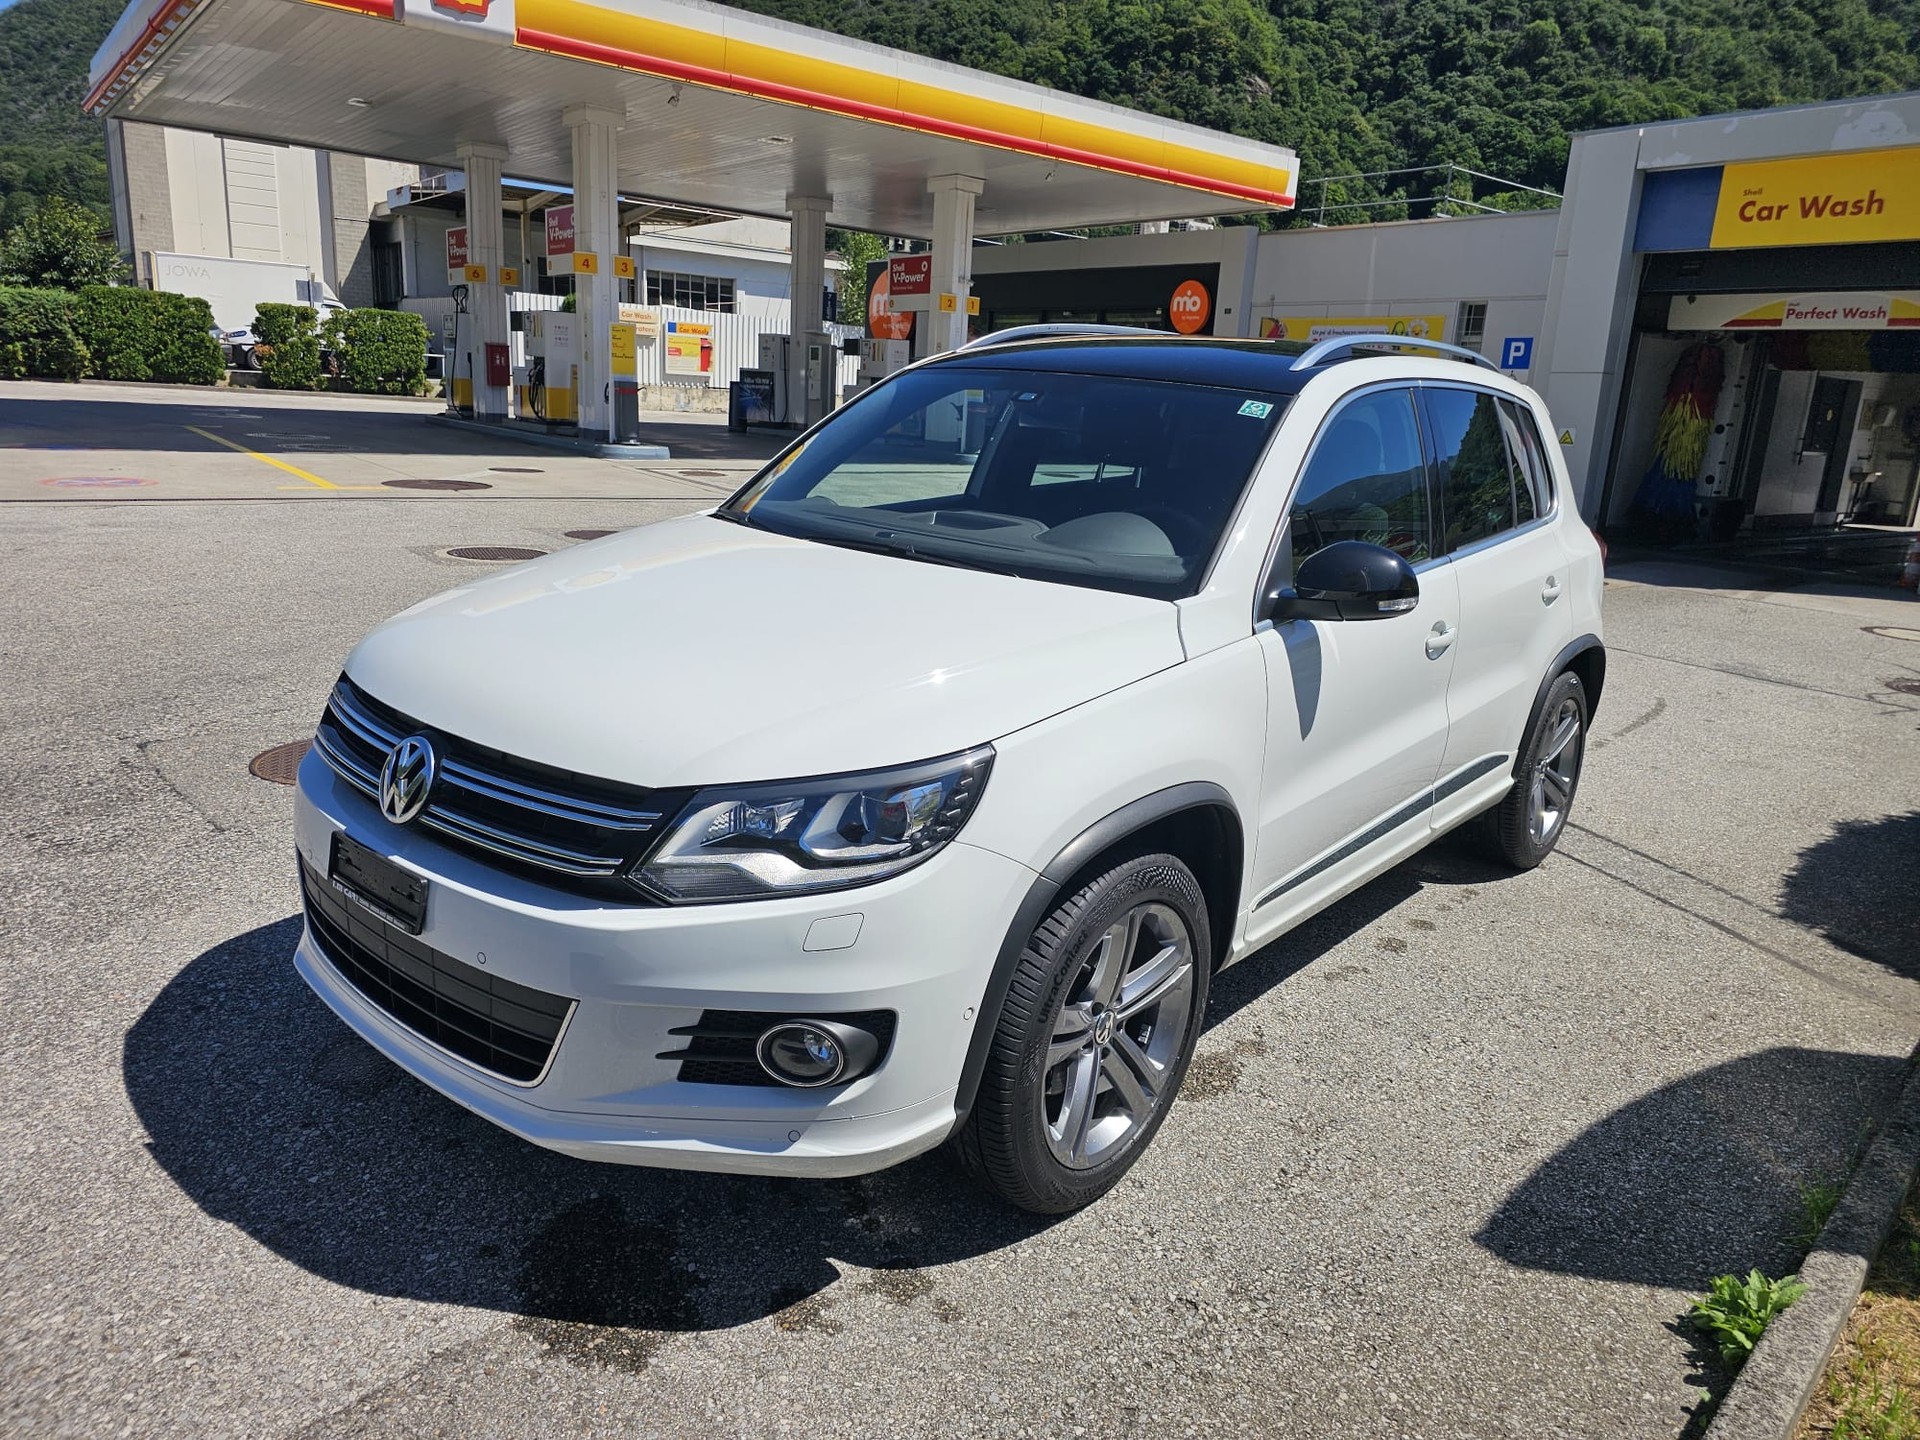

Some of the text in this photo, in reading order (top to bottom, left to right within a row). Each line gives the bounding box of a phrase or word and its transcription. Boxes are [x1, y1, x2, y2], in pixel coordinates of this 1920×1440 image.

[1743, 188, 1763, 196] Shell
[1738, 189, 1885, 222] Car Wash
[549, 228, 574, 240] V-Power
[582, 258, 590, 269] 4
[621, 262, 628, 273] 3
[893, 263, 905, 273] Shell
[166, 265, 210, 279] JOWA
[472, 269, 480, 279] 6
[505, 271, 511, 281] 5
[893, 273, 925, 284] V-Power
[947, 299, 952, 307] 2
[1173, 289, 1201, 312] mio
[1786, 306, 1887, 319] Perfect Wash
[679, 326, 690, 334] Car
[1508, 341, 1525, 365] P
[1038, 929, 1089, 1023] UltraContact
